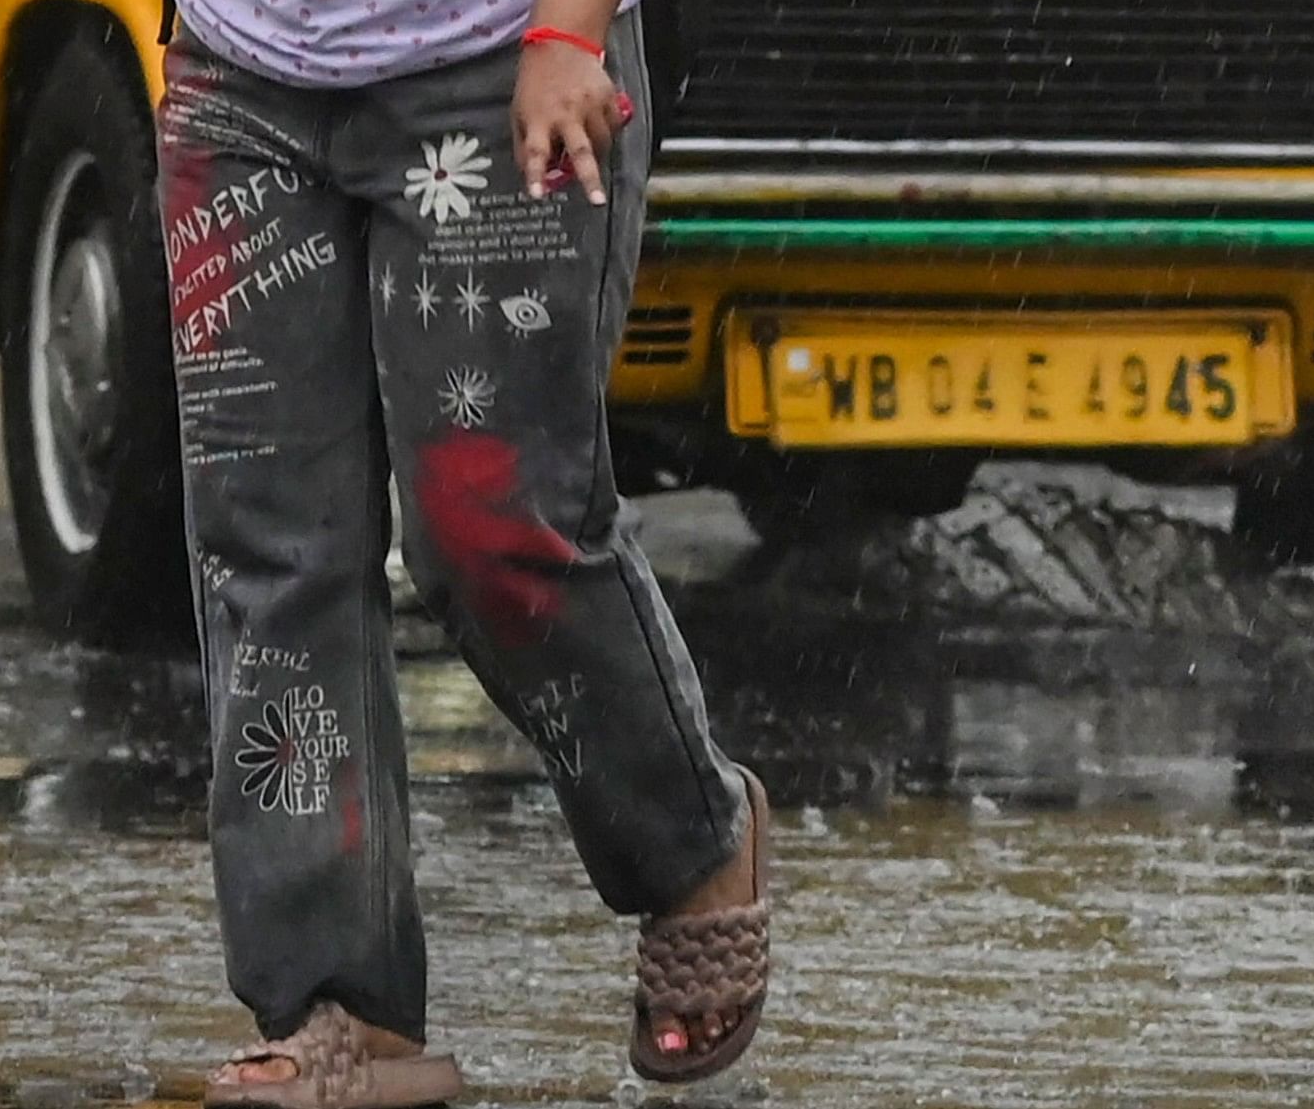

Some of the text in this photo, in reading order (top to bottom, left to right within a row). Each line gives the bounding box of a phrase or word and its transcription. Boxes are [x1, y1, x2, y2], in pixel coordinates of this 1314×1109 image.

[823, 352, 898, 421] WB
[294, 685, 324, 710] LO
[293, 709, 338, 738] VE
[294, 735, 350, 759] YOUR
[293, 759, 330, 784] SE
[295, 785, 330, 815] LF
